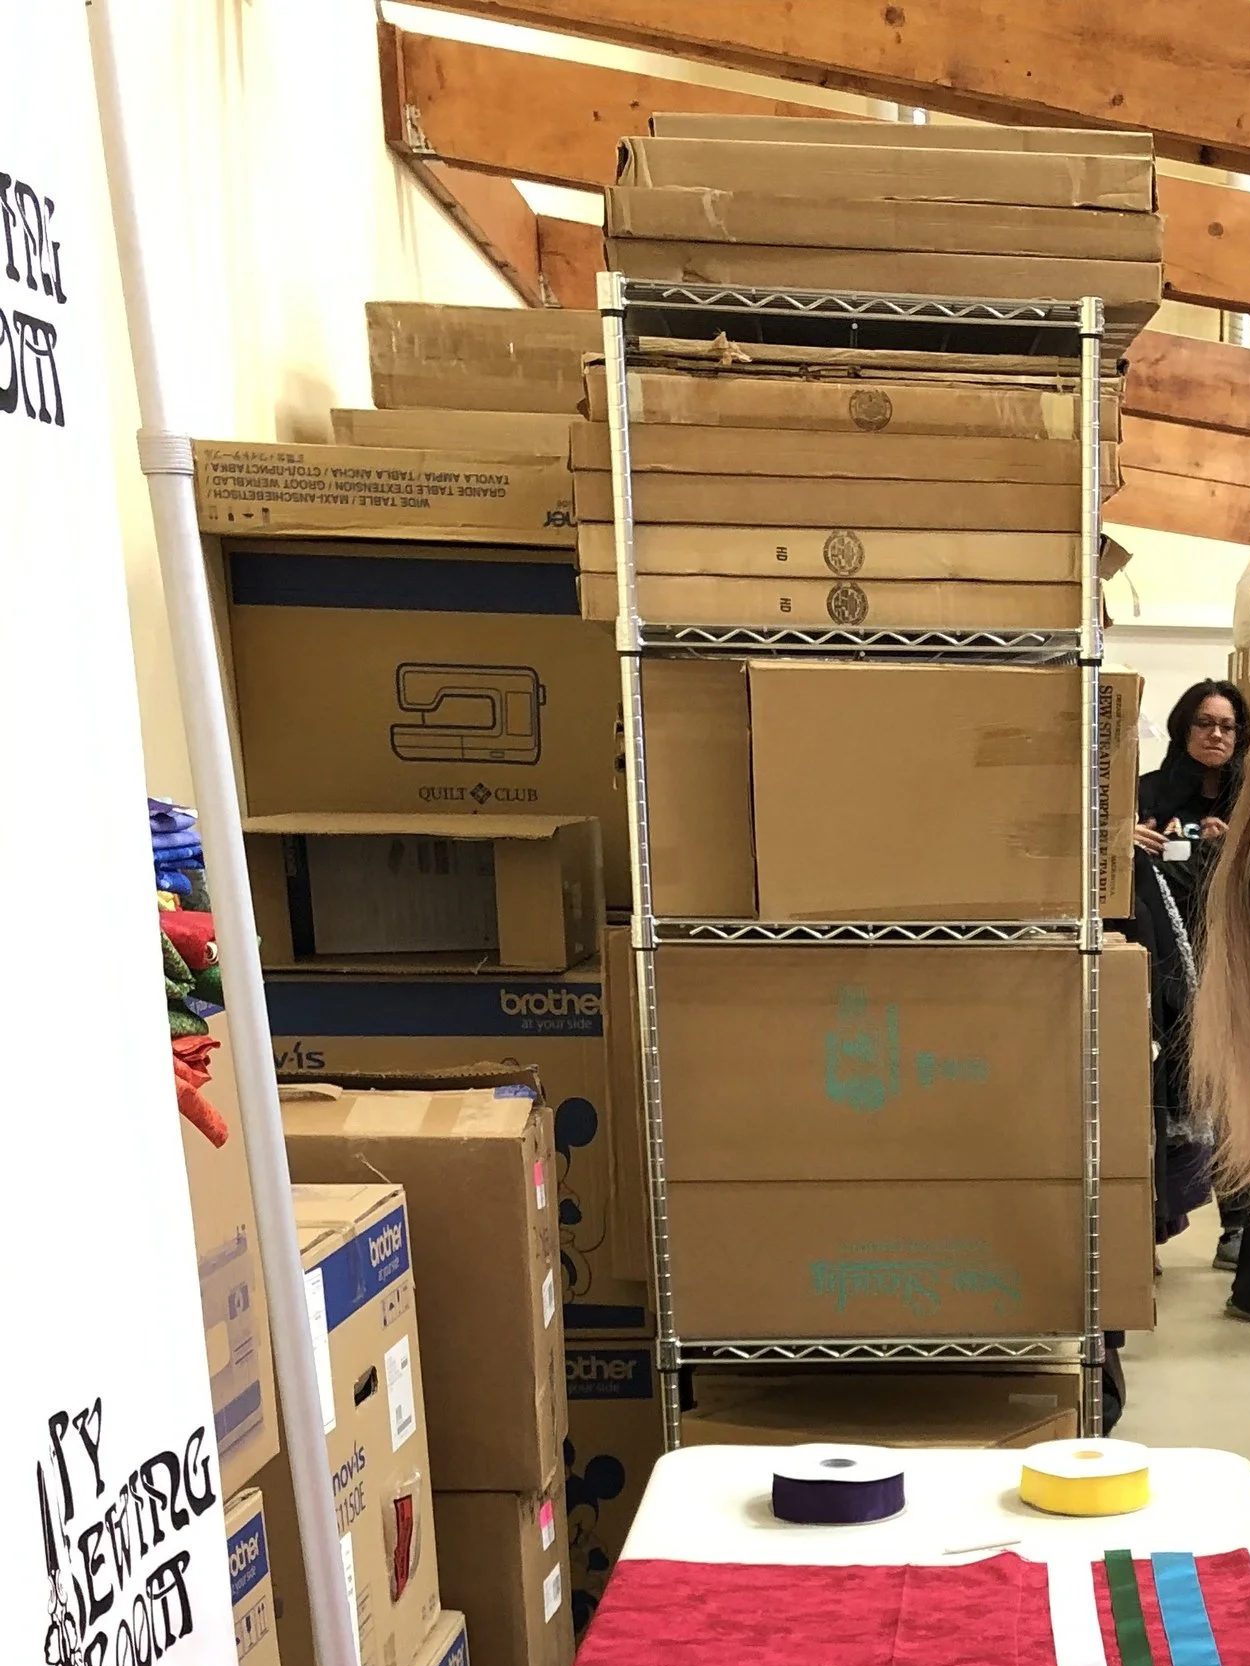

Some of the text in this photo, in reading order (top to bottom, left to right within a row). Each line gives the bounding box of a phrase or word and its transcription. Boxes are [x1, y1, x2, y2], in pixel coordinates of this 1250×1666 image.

[283, 479, 326, 491] GROOT
[425, 472, 460, 483] AMPIA
[465, 474, 510, 485] TAVOLA
[417, 485, 453, 496] TABLE
[458, 487, 506, 498] GRANDE
[360, 496, 397, 507] TABLE
[402, 498, 430, 508] WIDE
[776, 546, 788, 562] HD
[780, 598, 791, 613] HD
[1099, 685, 1113, 719] SEW
[1099, 721, 1112, 779] STEADY
[418, 786, 538, 802] QUILT CLUB
[500, 988, 602, 1016] brothe
[369, 1222, 402, 1267] brother
[565, 1355, 637, 1379] other
[335, 1480, 366, 1537] 1150E
[229, 1532, 259, 1577] other
